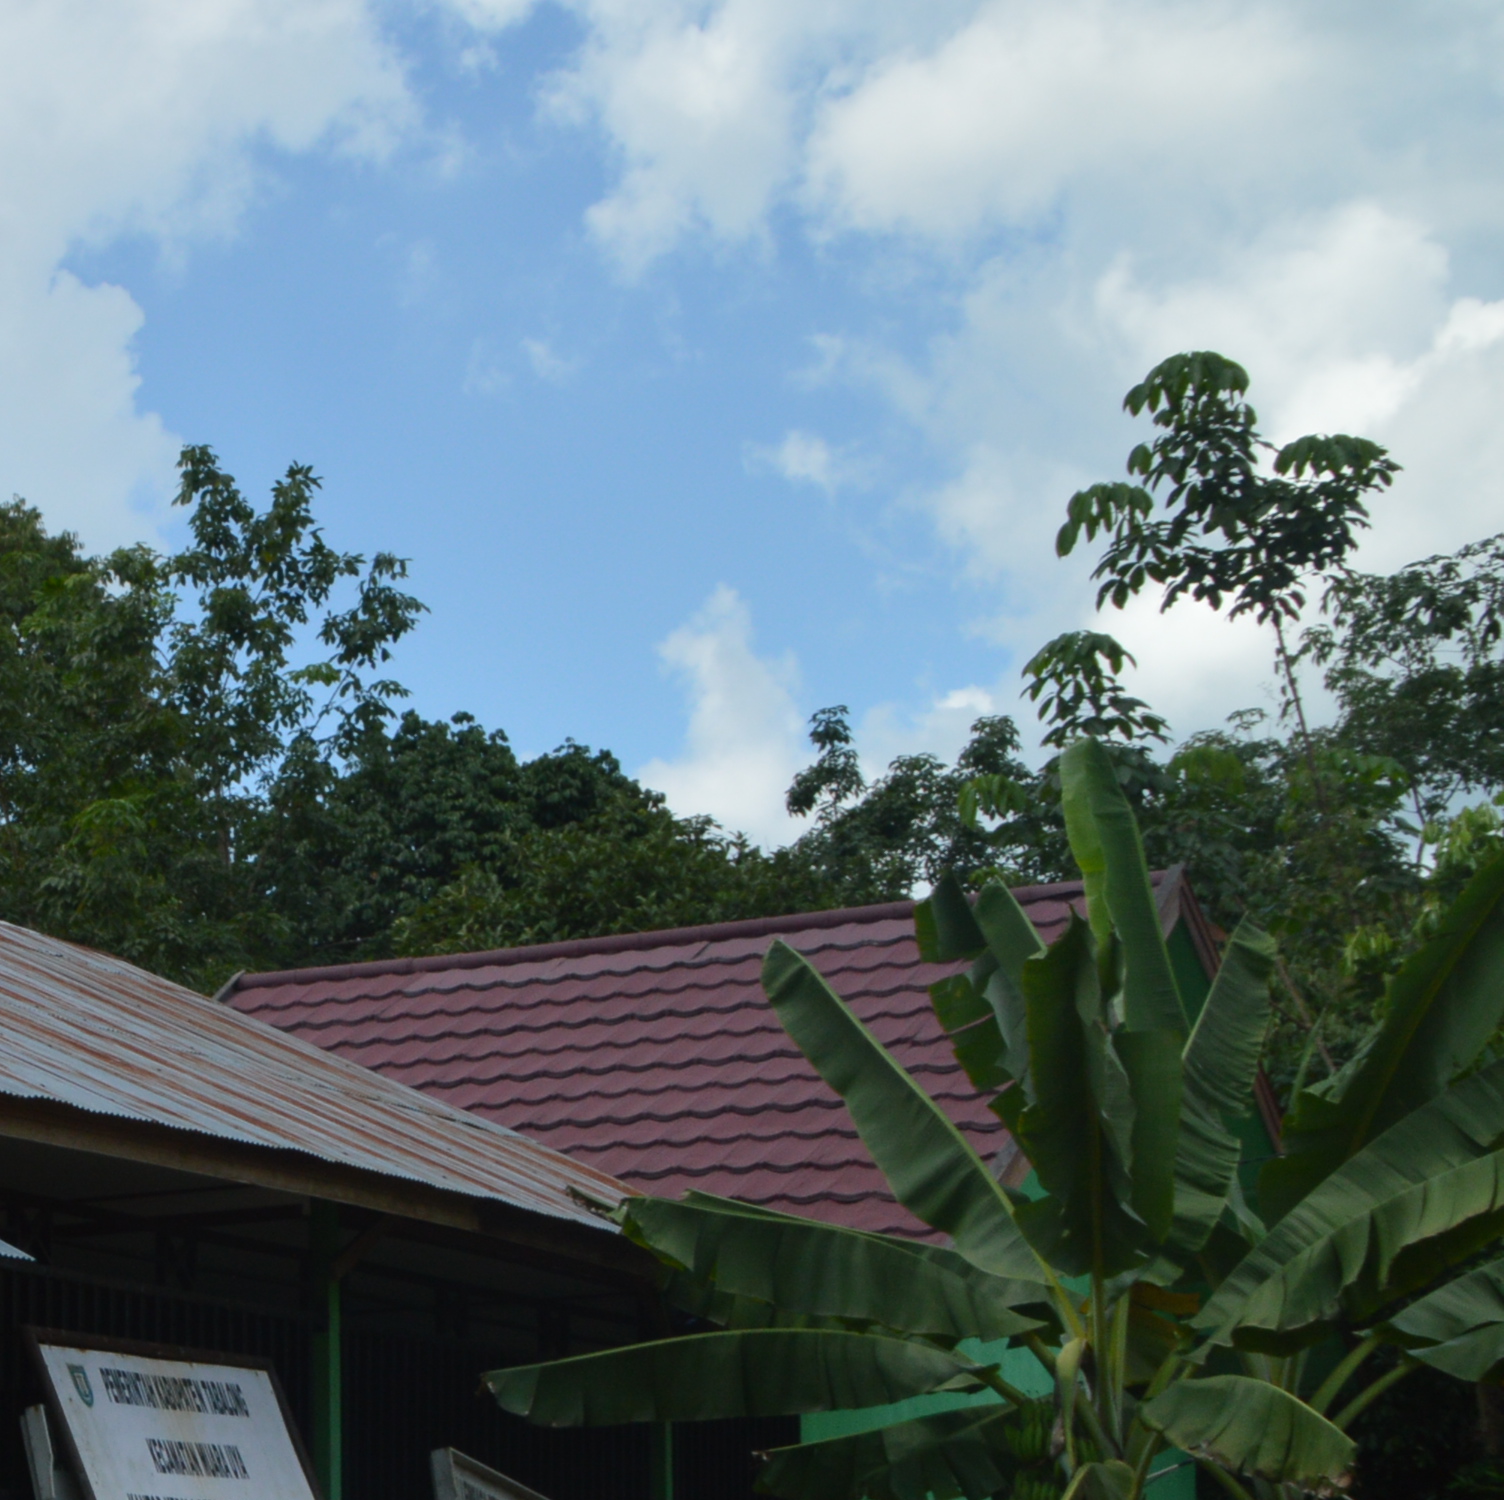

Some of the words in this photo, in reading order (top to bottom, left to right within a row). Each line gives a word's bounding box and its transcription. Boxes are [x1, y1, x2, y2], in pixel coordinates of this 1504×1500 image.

[97, 1367, 160, 1408] PEMERINTAH
[149, 1373, 209, 1413] KABUPATEN
[199, 1379, 251, 1417] TABALONG
[144, 1437, 204, 1476] KECAMATAN
[193, 1442, 233, 1478] MUARA
[222, 1444, 250, 1479] UYA
